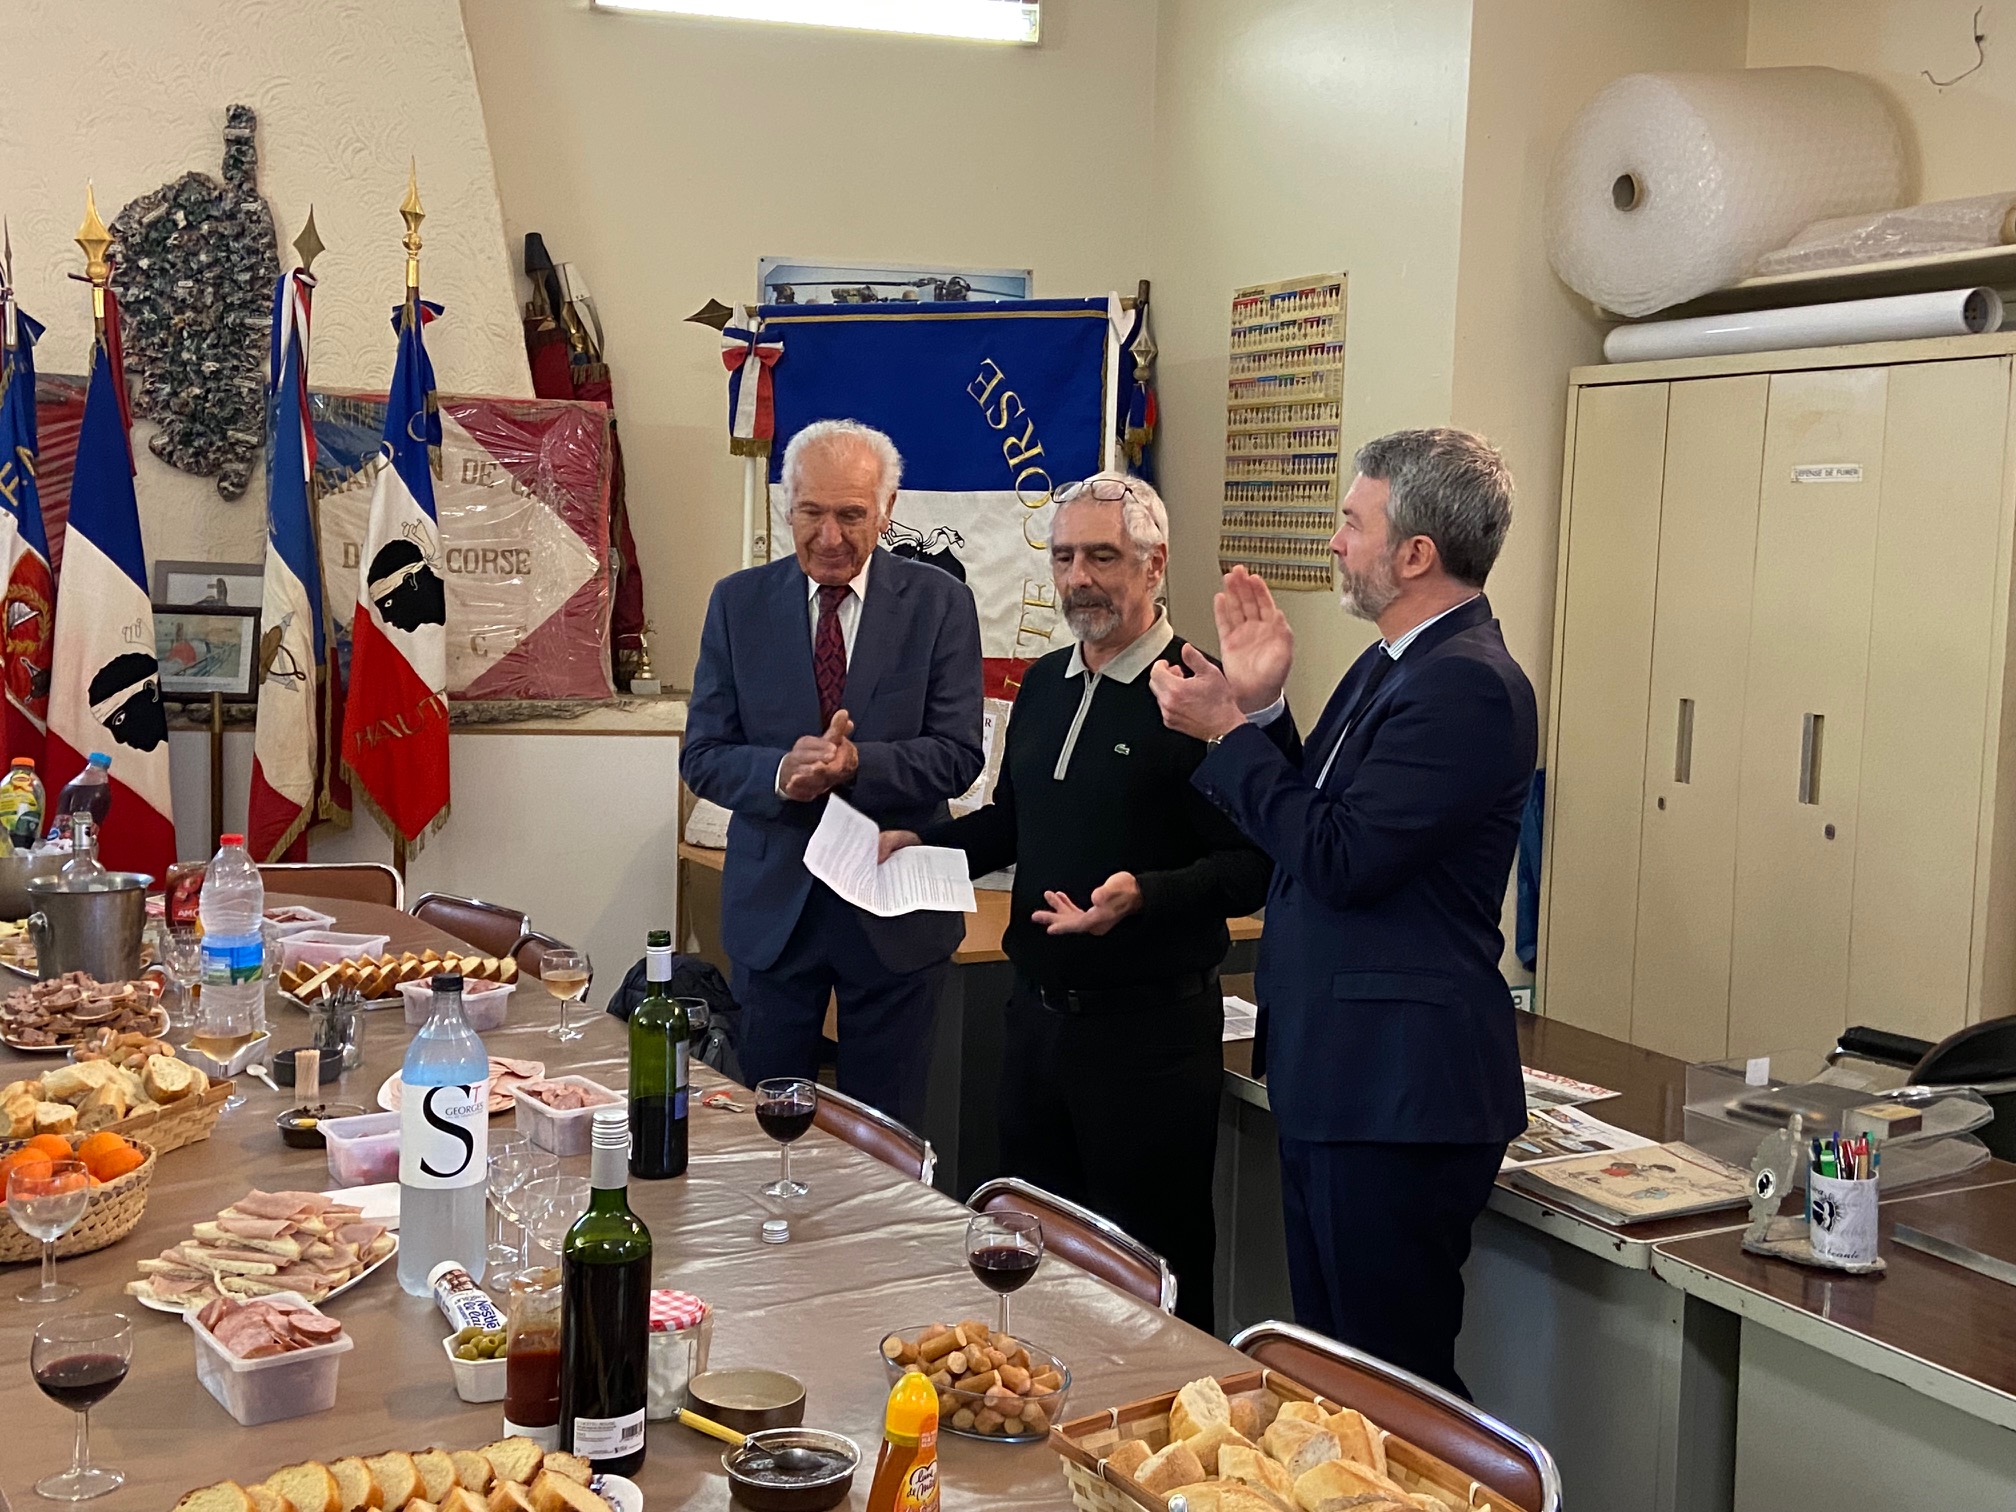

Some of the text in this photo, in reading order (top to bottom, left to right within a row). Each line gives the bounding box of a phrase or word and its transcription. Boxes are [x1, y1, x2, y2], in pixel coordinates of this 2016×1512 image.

[966, 357, 1053, 549] CORSE
[460, 457, 498, 489] DE
[446, 547, 531, 576] CORSE
[354, 689, 446, 753] HAUT
[445, 1103, 484, 1116] GEORGES
[475, 1300, 501, 1329] Nestlé
